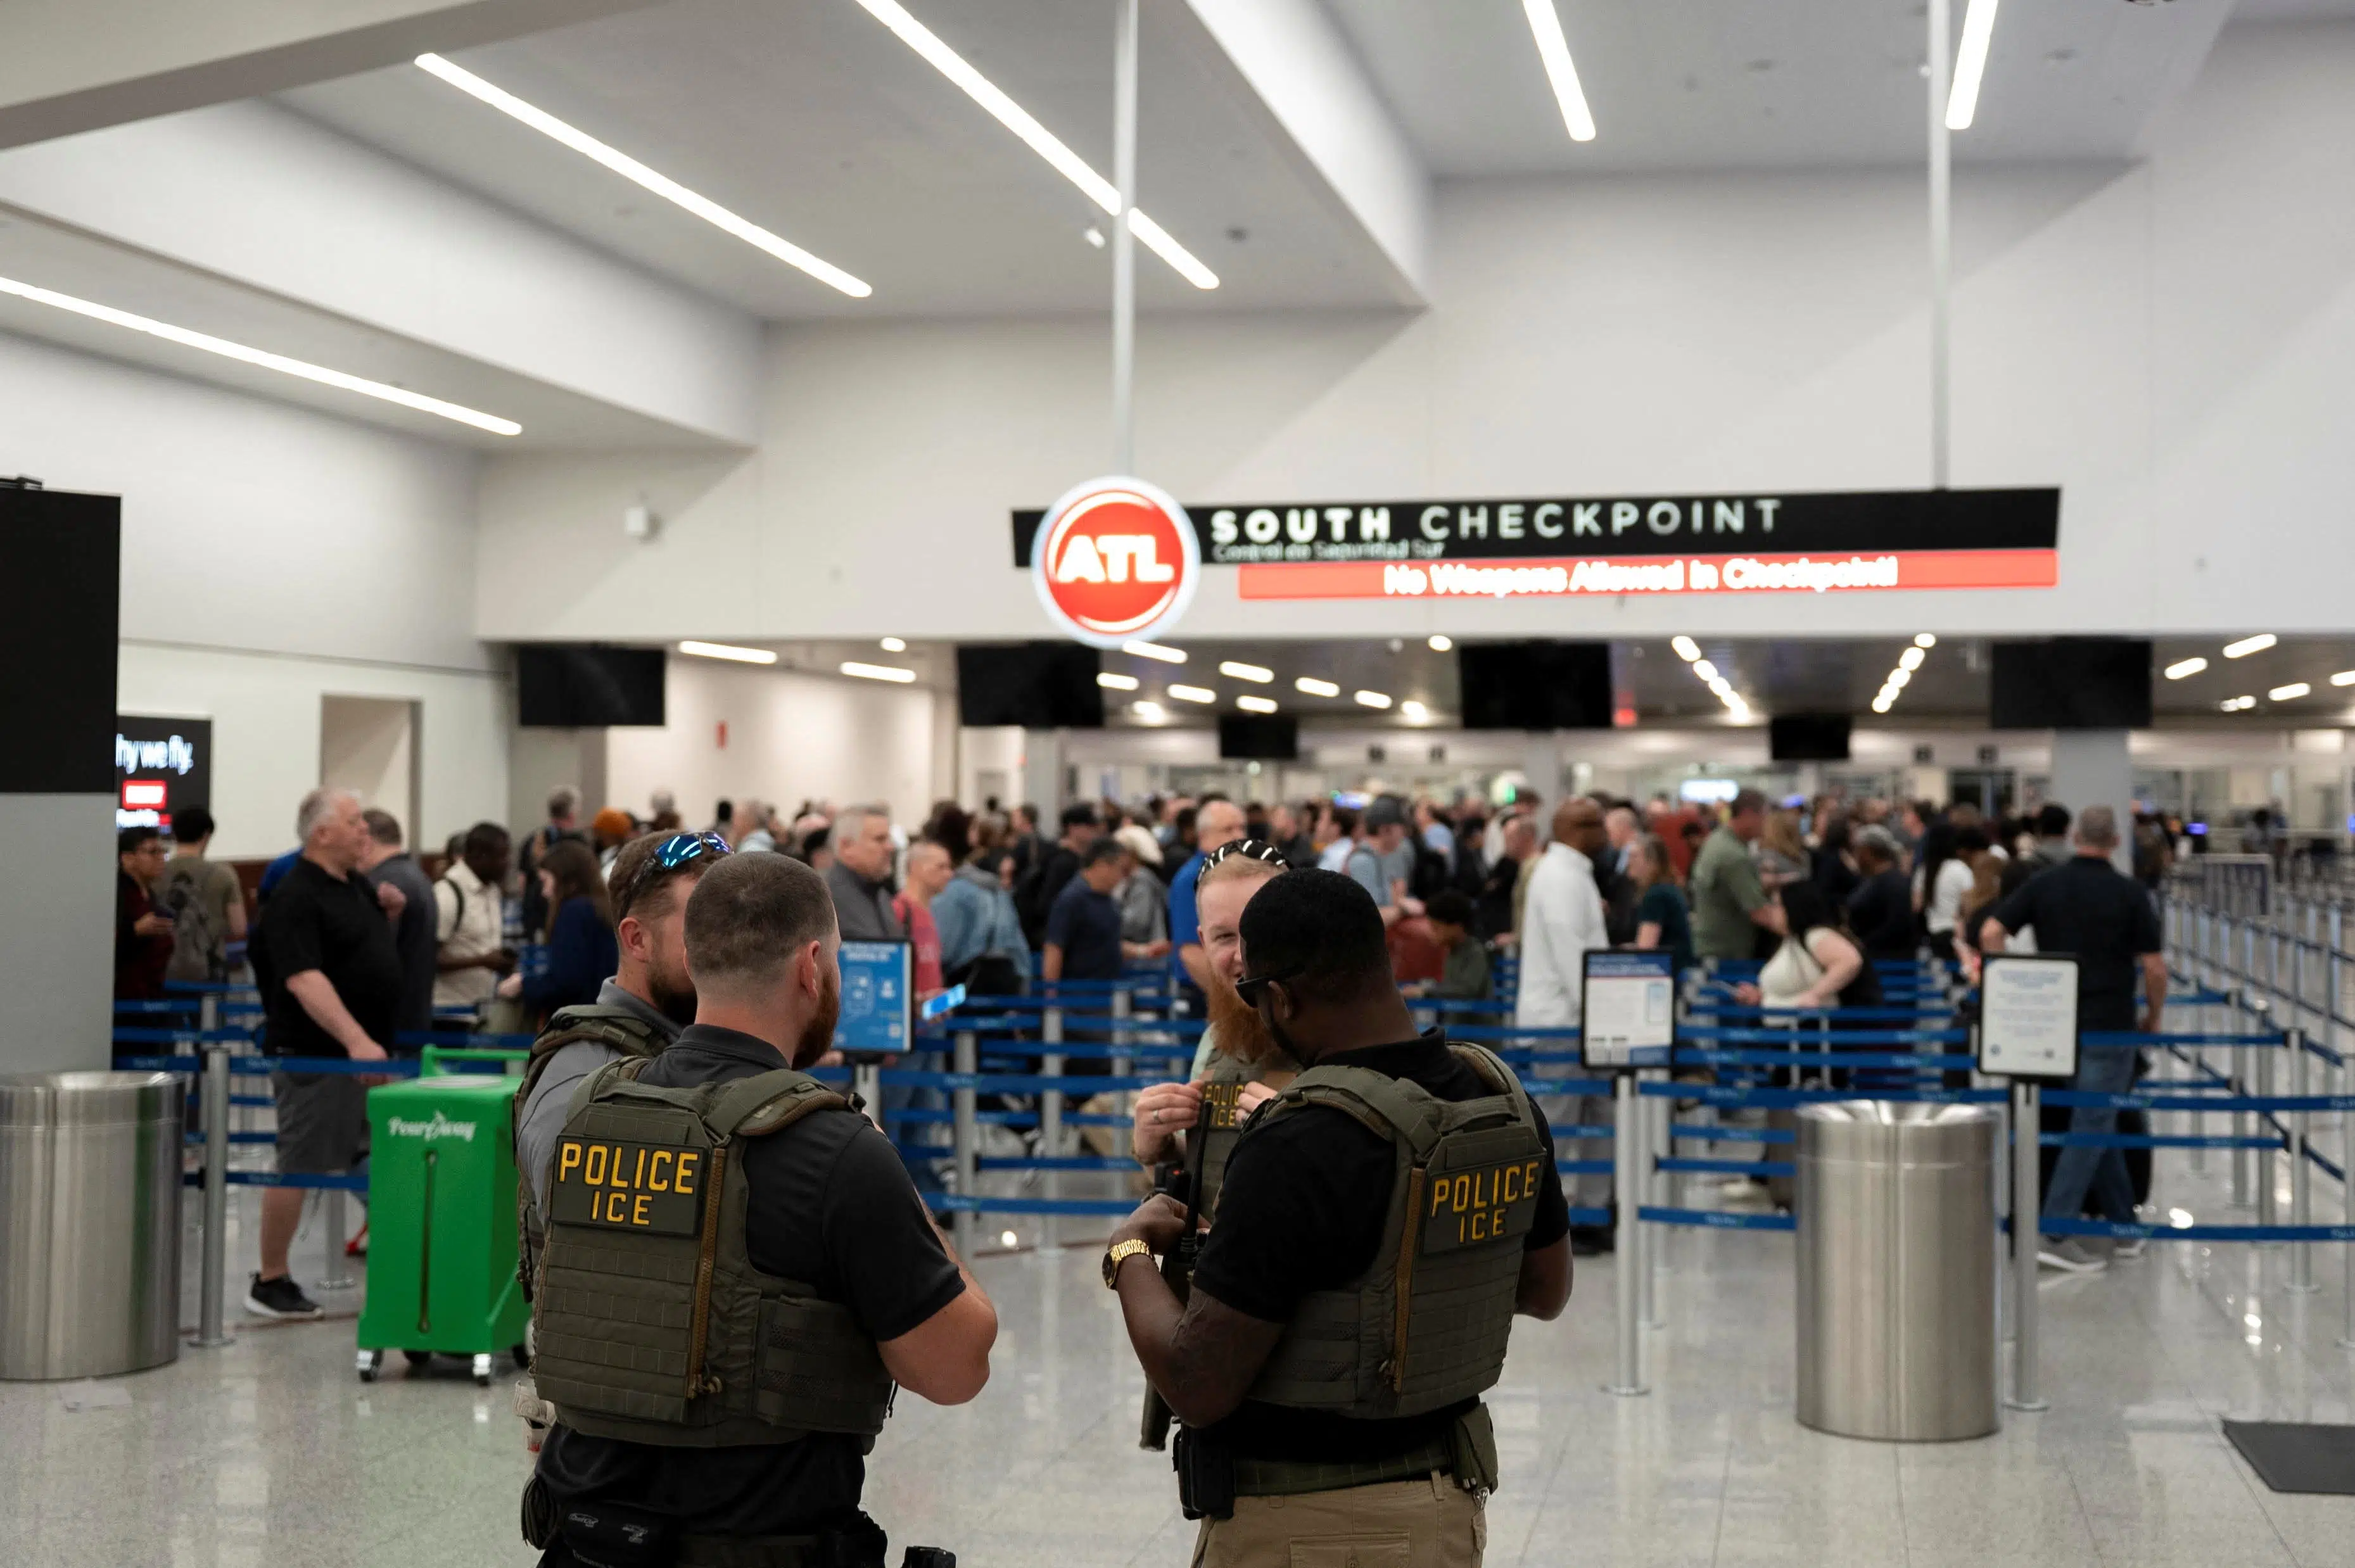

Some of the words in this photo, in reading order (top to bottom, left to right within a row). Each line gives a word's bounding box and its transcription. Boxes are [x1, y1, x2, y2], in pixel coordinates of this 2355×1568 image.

[1210, 507, 1390, 543] SOUTH
[1419, 499, 1781, 540] CHECKPOINT
[1057, 534, 1174, 583] ATL
[1383, 564, 1427, 595] No
[1429, 563, 1568, 598] Weapons
[1568, 559, 1684, 591] Allowed
[116, 733, 139, 775] hy
[1205, 1084, 1244, 1106] POLIC
[559, 1142, 698, 1194] POLICE
[592, 1190, 653, 1225] ICE
[1431, 1162, 1539, 1217] POLICE
[1459, 1208, 1506, 1243] ICE
